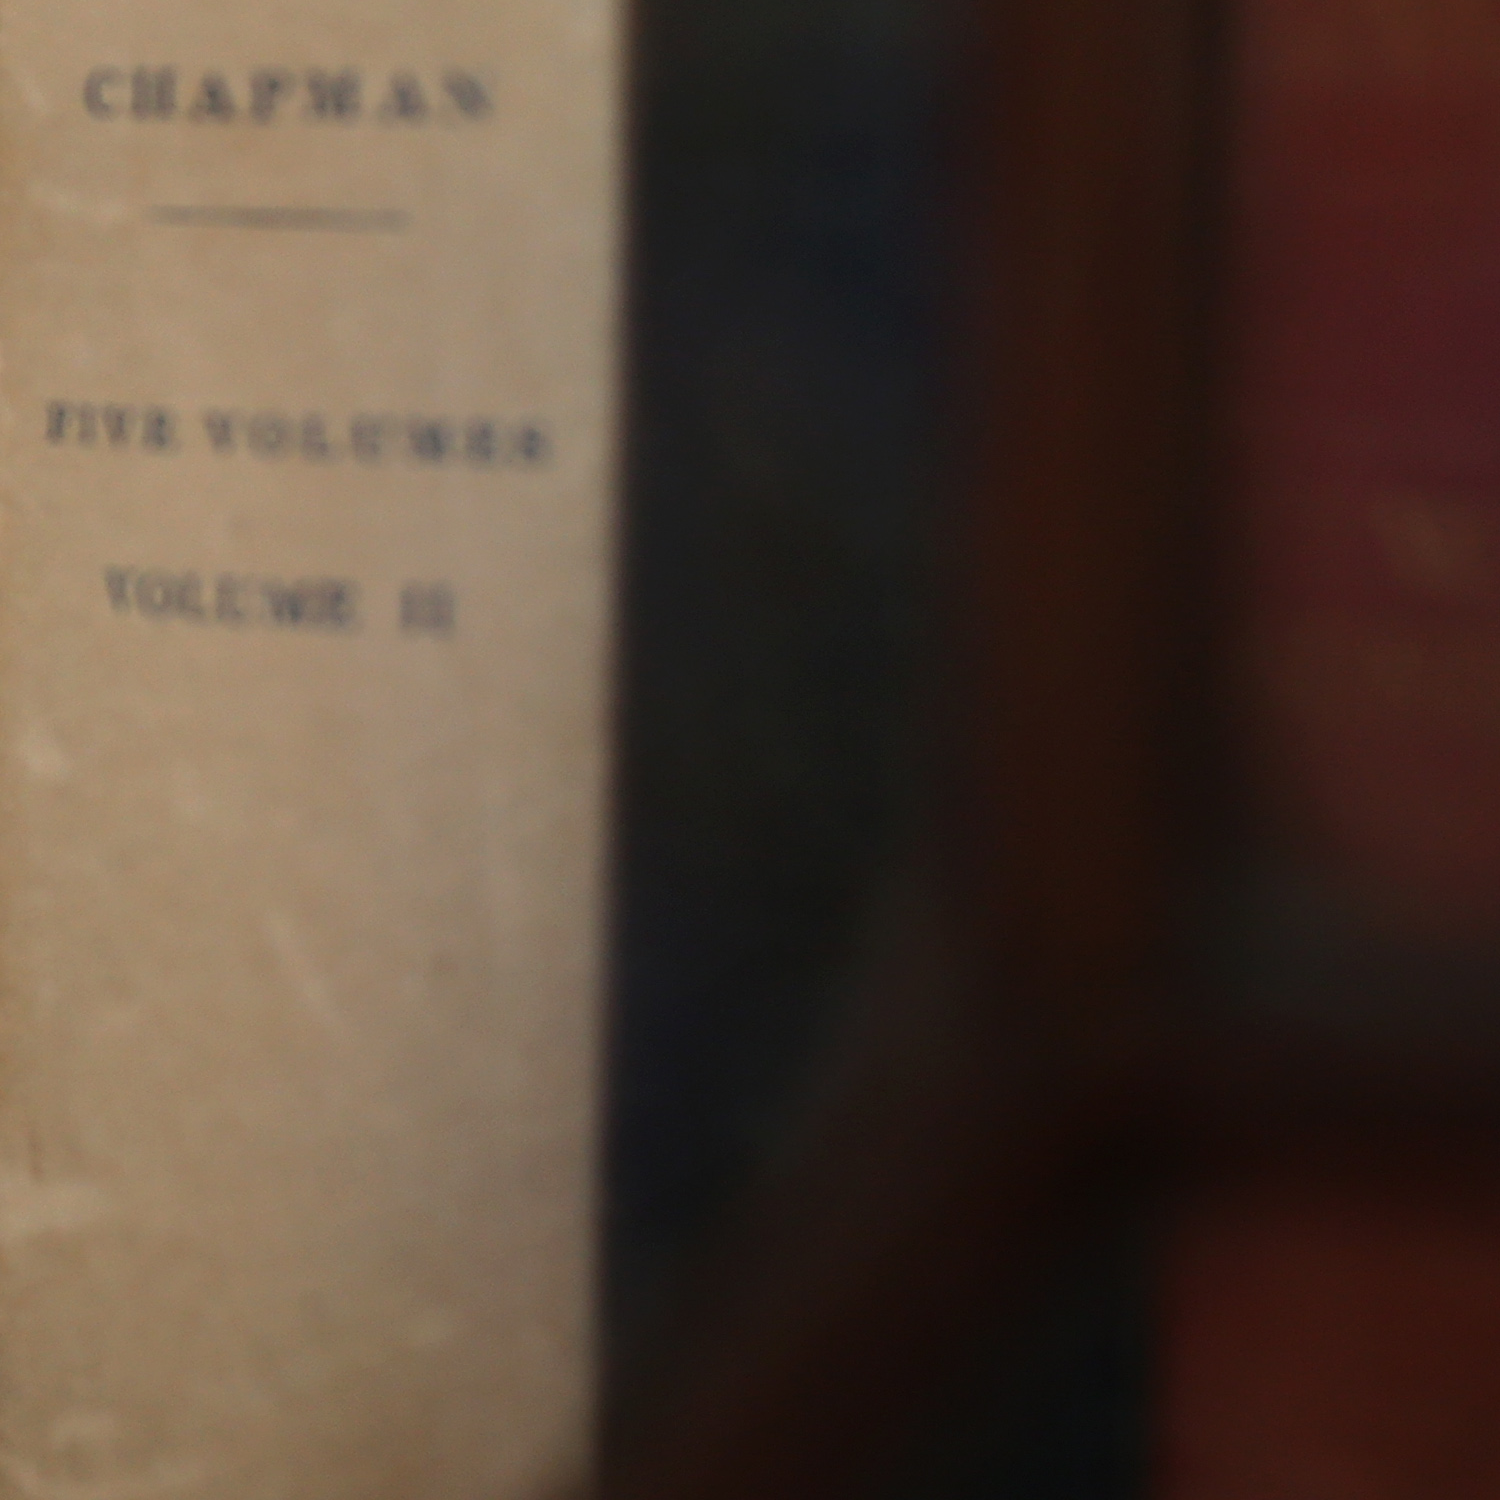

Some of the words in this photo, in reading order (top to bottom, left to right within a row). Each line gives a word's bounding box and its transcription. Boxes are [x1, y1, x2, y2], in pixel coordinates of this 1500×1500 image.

[85, 66, 498, 127] CHAPMAN
[45, 400, 177, 452] FIVE
[204, 412, 552, 469] VOLUMES
[102, 566, 361, 634] VOLUME
